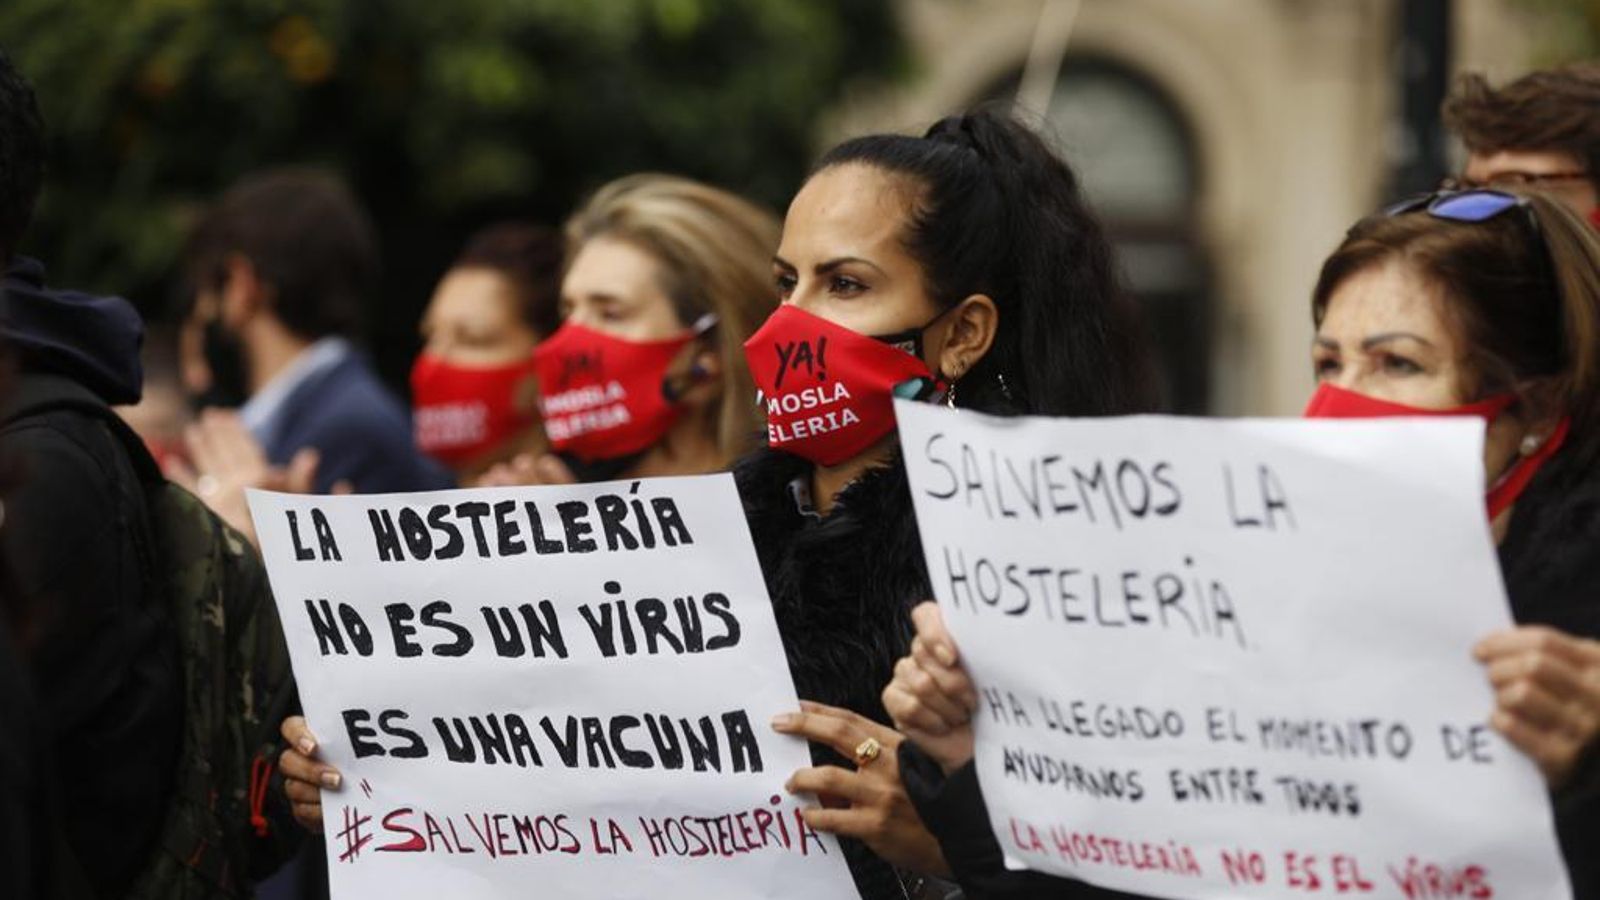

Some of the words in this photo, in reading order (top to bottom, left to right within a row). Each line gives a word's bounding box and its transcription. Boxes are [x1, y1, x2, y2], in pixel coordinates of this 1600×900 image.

[774, 336, 827, 389] YA!
[925, 433, 1184, 530] SALVEMOS
[1222, 461, 1299, 533] LA
[286, 508, 342, 562] LA
[367, 481, 694, 562] HOSTELERÍA
[305, 599, 374, 657] NO
[384, 600, 474, 658] ES
[480, 600, 568, 658] UN
[342, 709, 429, 759] ES
[432, 713, 542, 768] UNA
[540, 709, 764, 772] VACUNA
[983, 688, 1032, 728] HA
[1038, 697, 1185, 740] LLEGADO
[1206, 706, 1246, 744] EL
[1441, 723, 1495, 765] DE
[1002, 747, 1145, 801] AYUDARNOS
[1169, 767, 1263, 803] ENTRE
[336, 804, 581, 864] #SALVEMOS
[590, 818, 633, 855] LA
[1008, 817, 1043, 854] LA
[1220, 848, 1266, 884] NO
[1286, 851, 1319, 890] ES
[1331, 854, 1374, 892] EL
